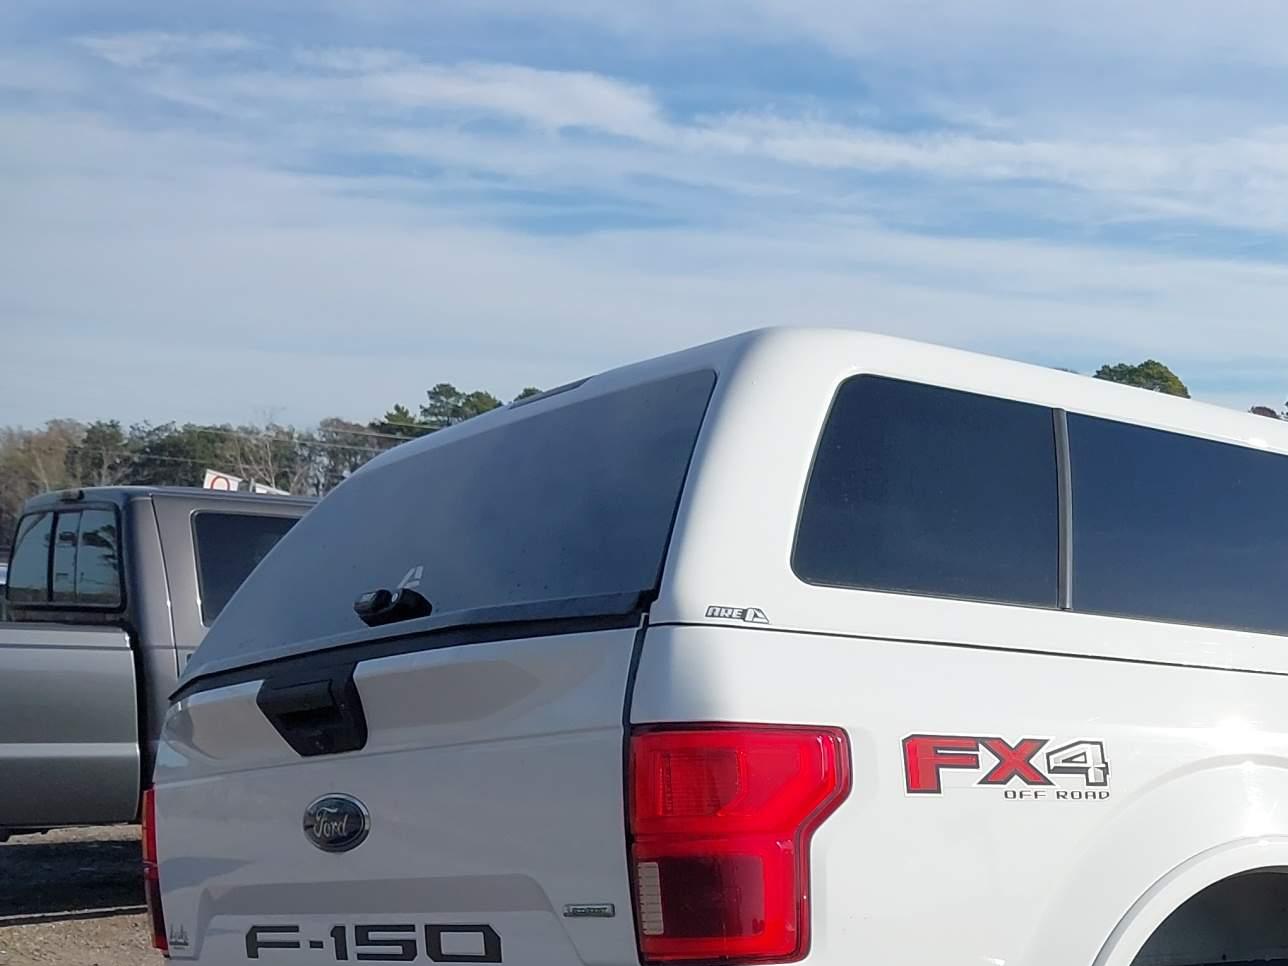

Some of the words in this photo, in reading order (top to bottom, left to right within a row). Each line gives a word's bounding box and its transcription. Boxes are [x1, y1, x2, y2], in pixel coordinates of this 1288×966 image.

[902, 734, 1109, 794] FX4
[1003, 790, 1047, 800] OFF
[1056, 790, 1110, 800] ROAD
[312, 806, 350, 838] Ford
[245, 924, 502, 963] F-150
